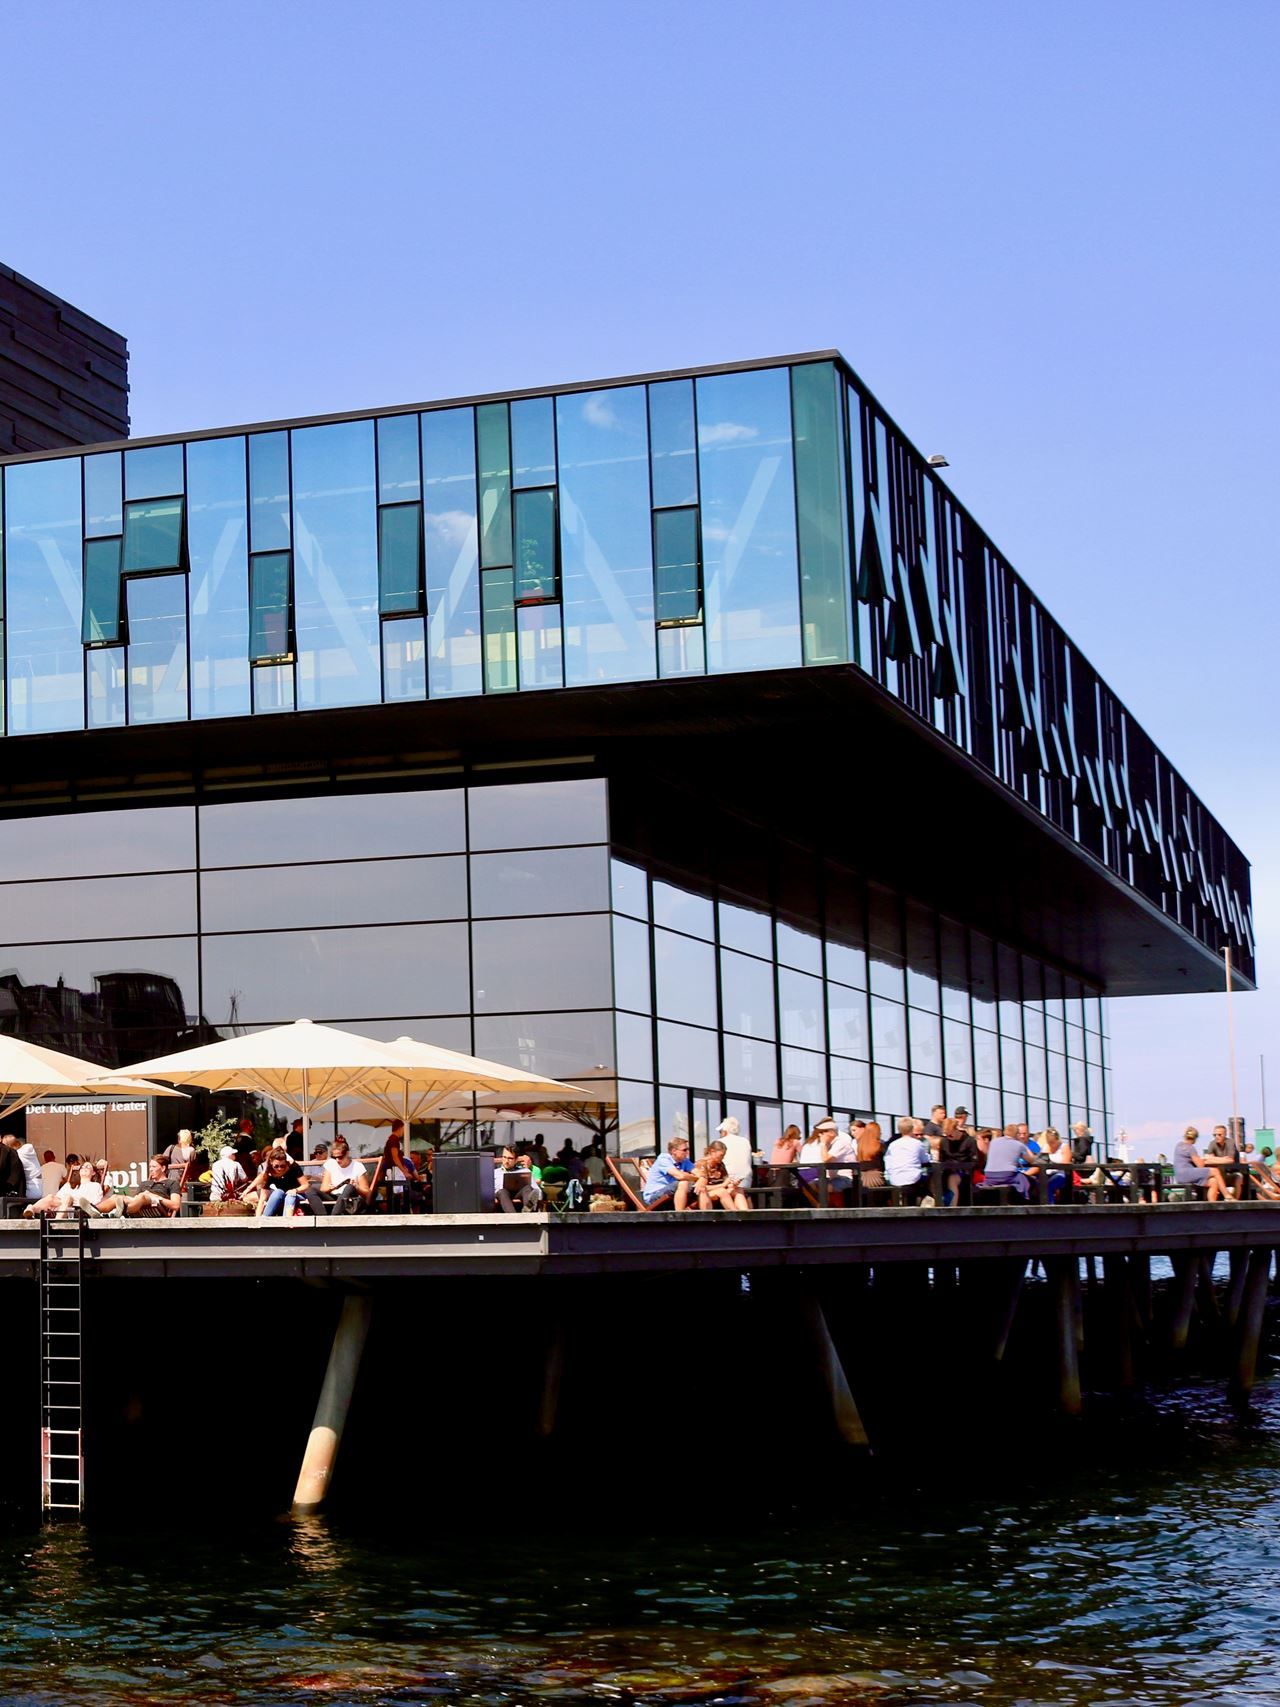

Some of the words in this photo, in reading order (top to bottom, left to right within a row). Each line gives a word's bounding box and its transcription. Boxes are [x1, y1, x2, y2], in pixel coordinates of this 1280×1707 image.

[26, 1104, 46, 1115] Det
[49, 1103, 106, 1115] Kongelige
[110, 1102, 147, 1112] Teater
